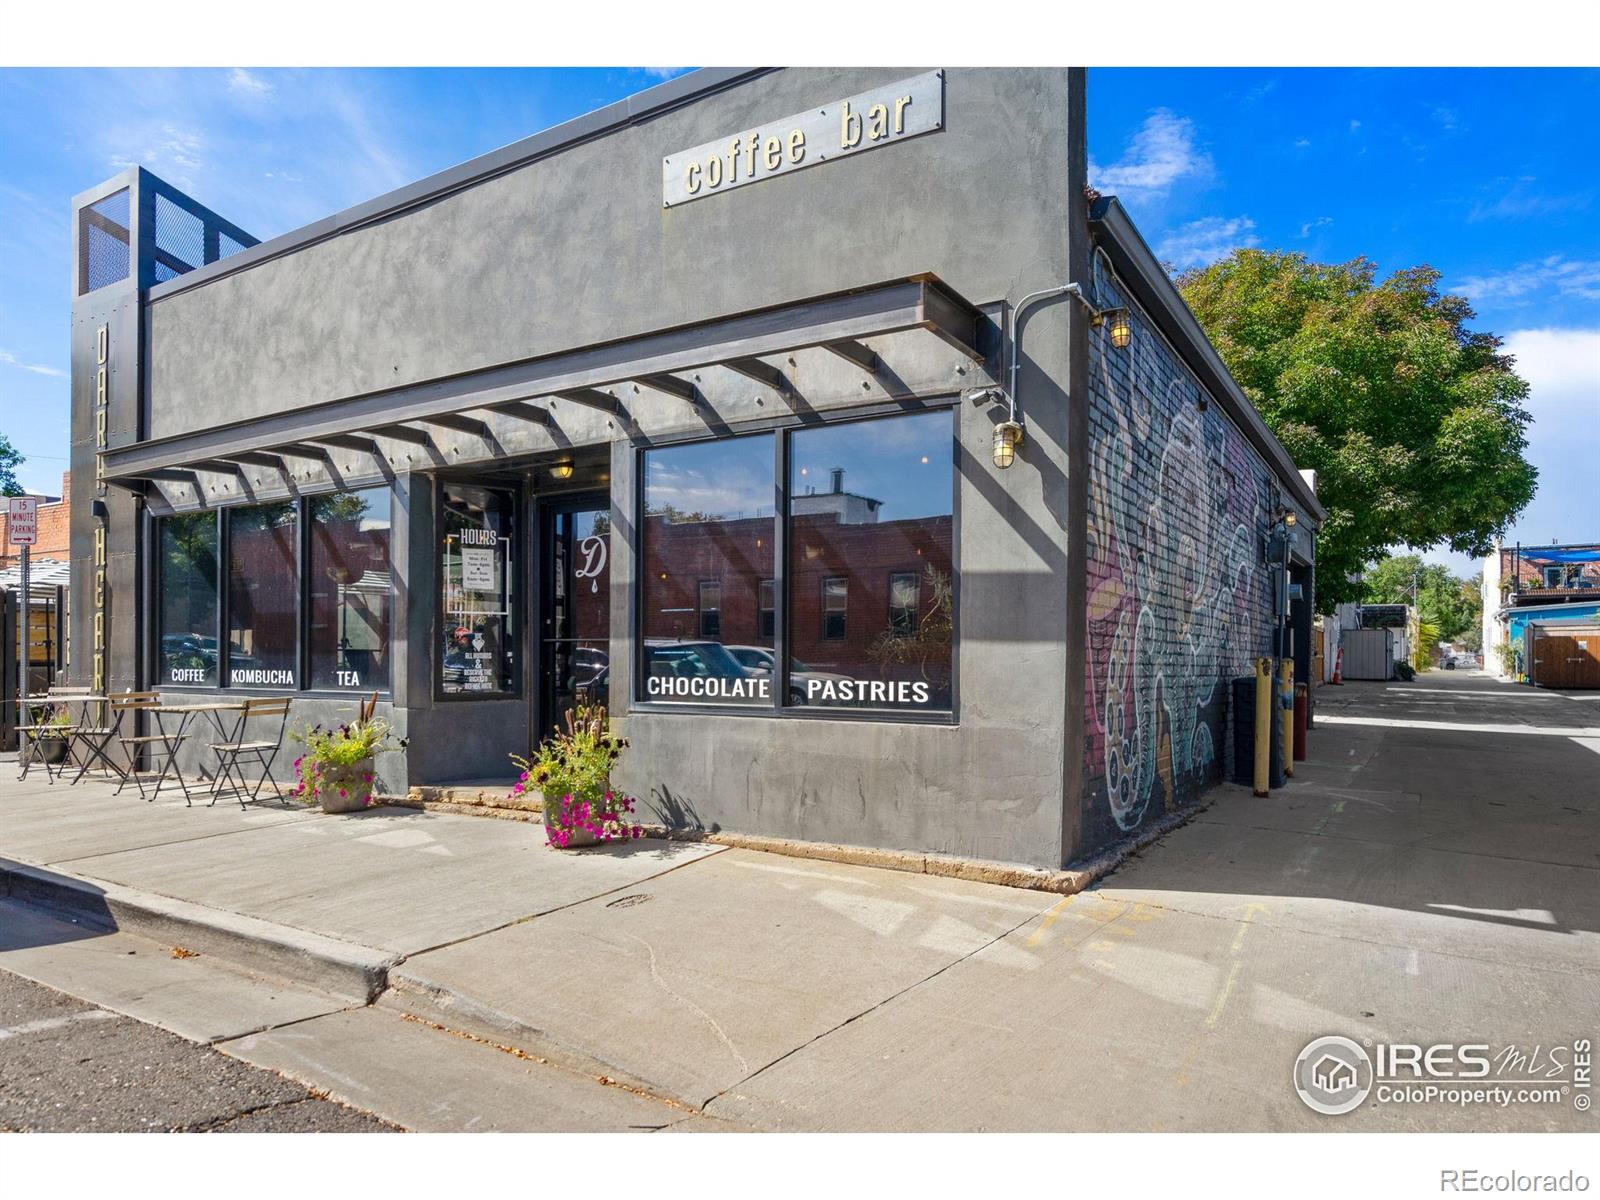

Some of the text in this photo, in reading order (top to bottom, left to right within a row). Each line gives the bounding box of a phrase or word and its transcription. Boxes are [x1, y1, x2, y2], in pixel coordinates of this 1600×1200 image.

[684, 95, 912, 194] coffee bar
[19, 501, 27, 510] 15
[12, 512, 34, 521] MINUTE
[10, 525, 35, 534] PARKING
[460, 528, 497, 546] HOURS
[475, 659, 482, 669] &
[171, 668, 205, 682] COFFEE
[231, 669, 294, 685] KOMBUCHA
[337, 671, 360, 686] TEA
[647, 676, 770, 698] CHOCOLATE
[807, 679, 929, 703] PASTRIES
